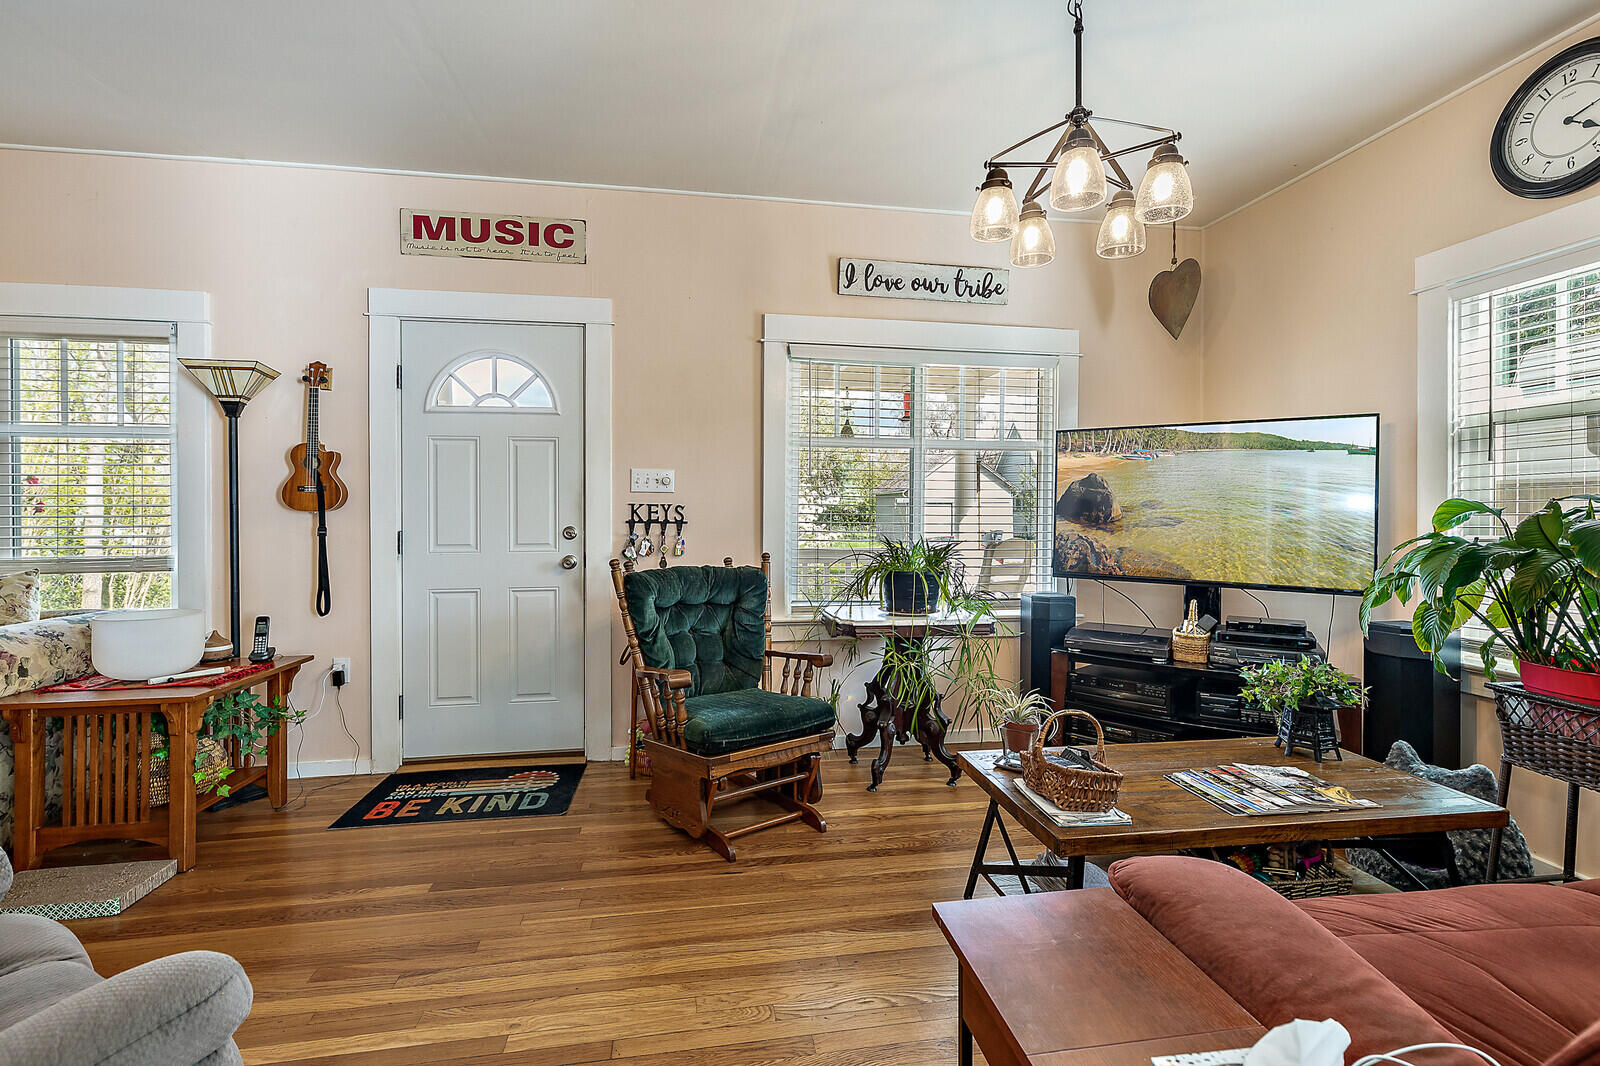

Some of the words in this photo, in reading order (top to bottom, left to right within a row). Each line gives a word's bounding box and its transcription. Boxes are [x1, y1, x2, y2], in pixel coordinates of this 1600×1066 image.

[1561, 69, 1577, 86] 12
[1536, 88, 1552, 102] 11
[1519, 112, 1535, 125] 10
[1514, 137, 1528, 147] 9
[1521, 153, 1534, 166] 8
[1566, 156, 1576, 170] 6
[1542, 160, 1553, 174] 7
[412, 214, 575, 249] MUSIC
[406, 242, 438, 250] Music
[843, 262, 858, 289] I
[864, 262, 906, 292] love
[911, 277, 949, 294] our
[953, 268, 1006, 299] tribe
[627, 503, 686, 522] KEYS
[362, 799, 432, 820] BE
[435, 792, 550, 815] KIND
